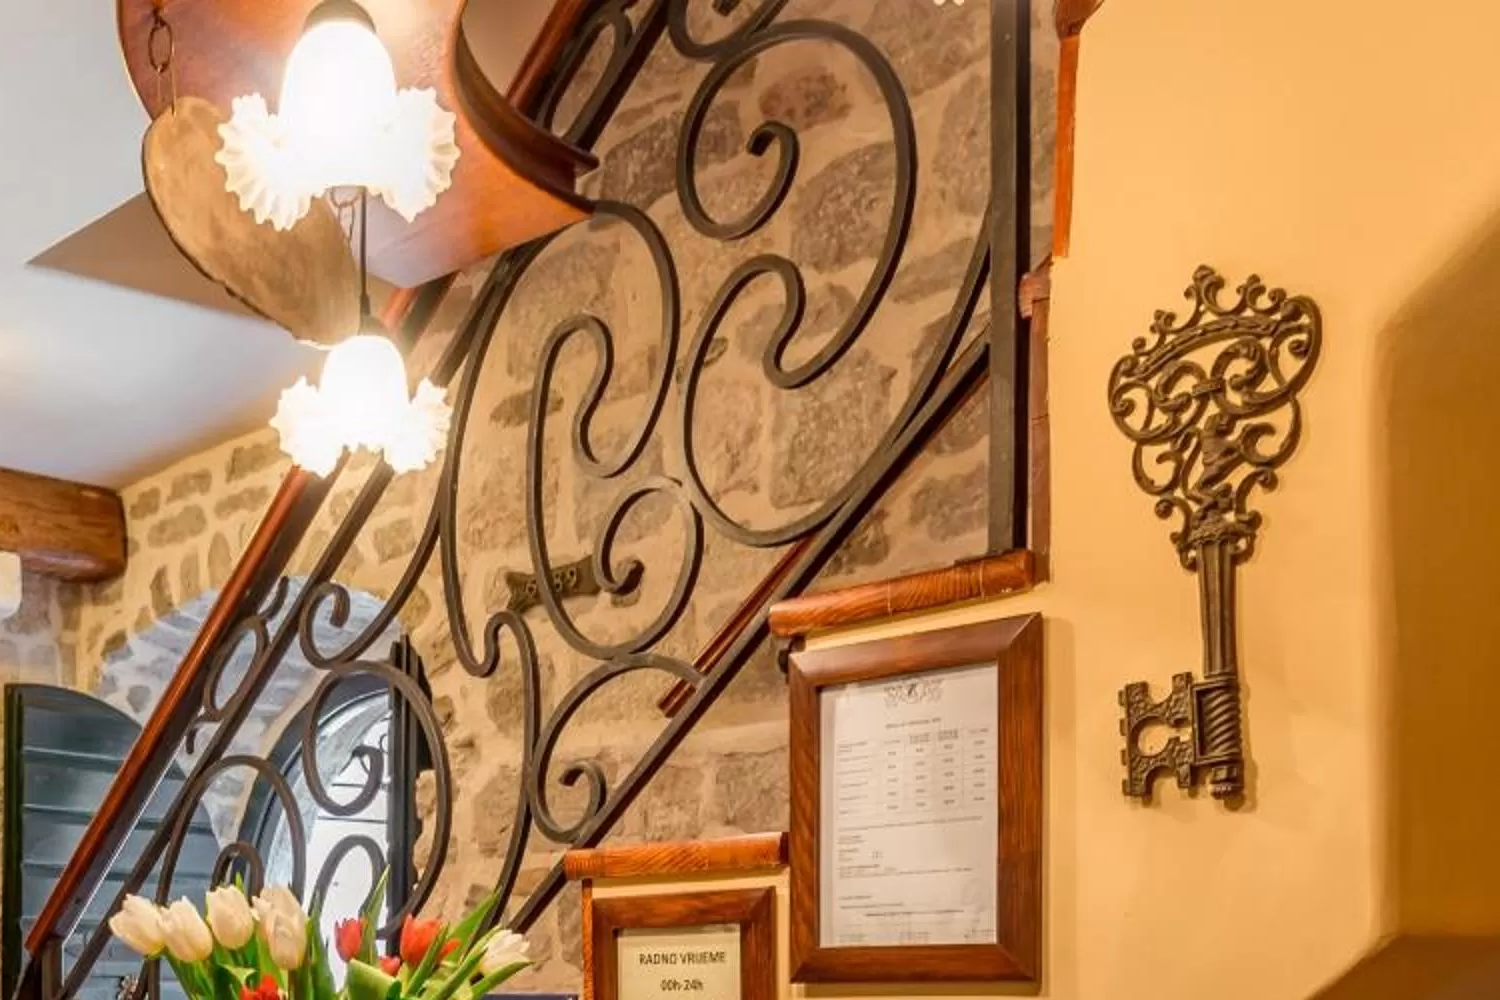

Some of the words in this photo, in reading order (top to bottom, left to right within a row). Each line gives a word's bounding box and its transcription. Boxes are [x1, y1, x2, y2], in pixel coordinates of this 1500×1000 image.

[638, 952, 678, 965] RADNO
[679, 951, 726, 964] VRIJEME
[660, 978, 705, 991] 00h-24h
